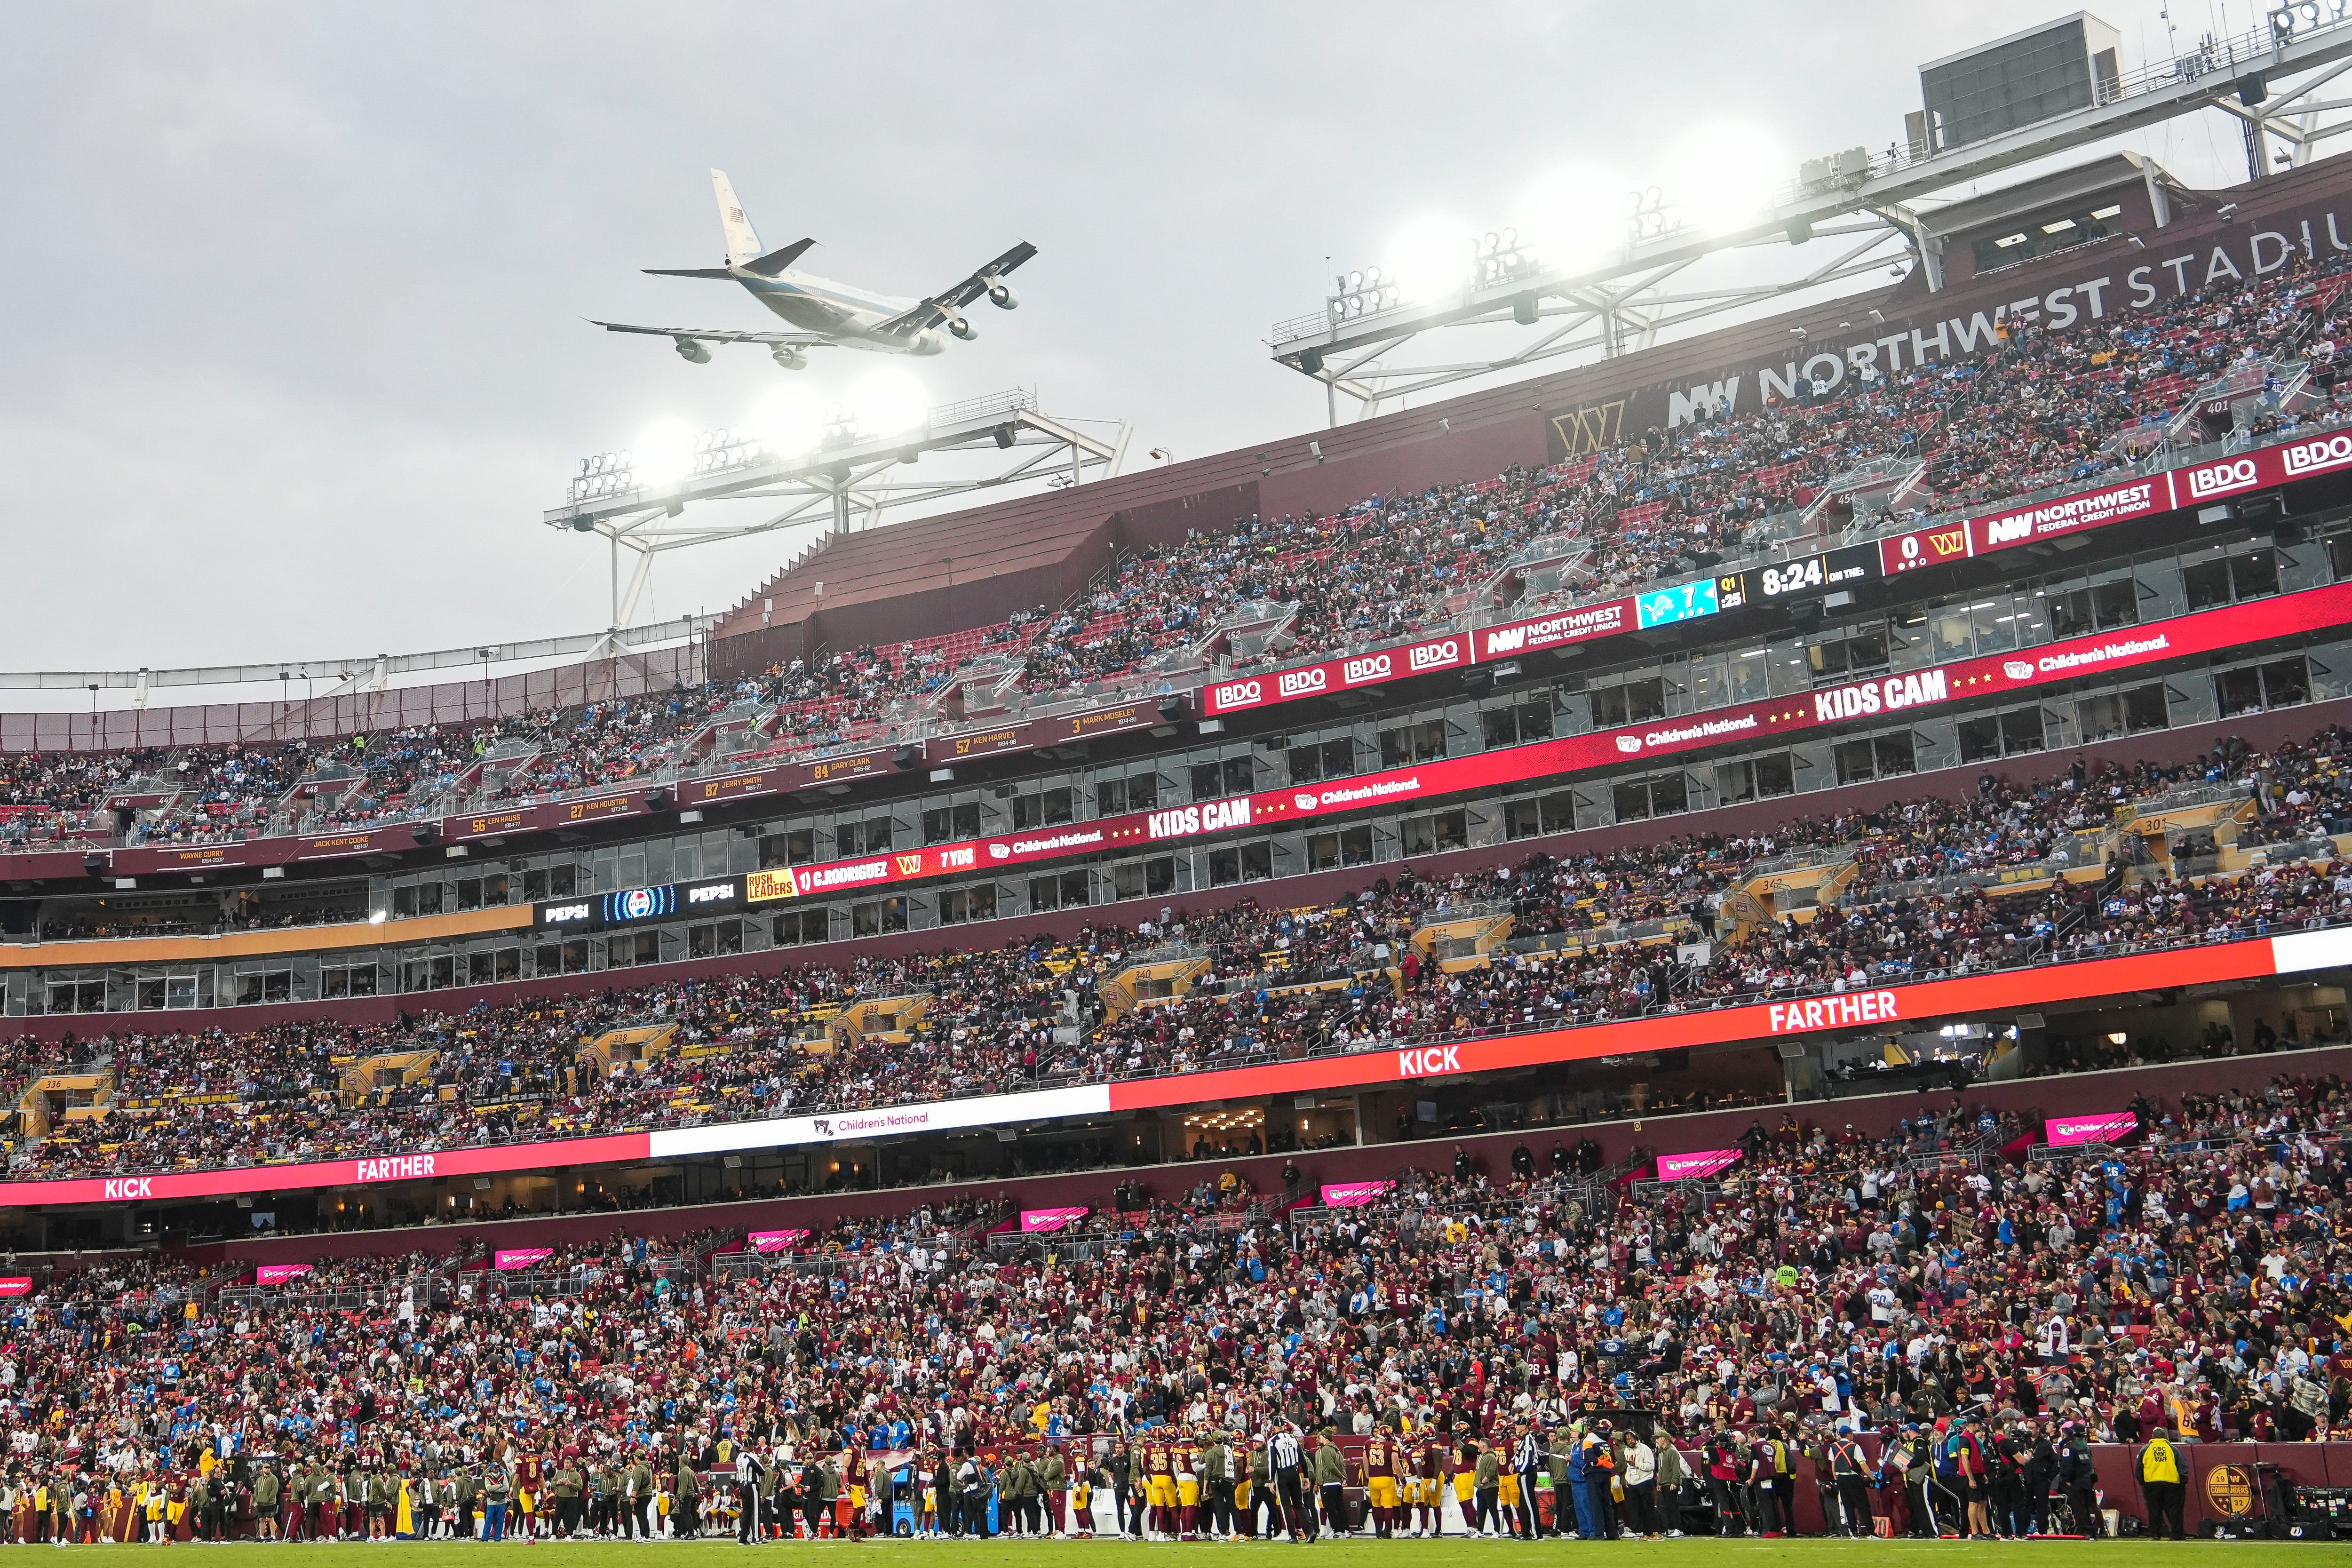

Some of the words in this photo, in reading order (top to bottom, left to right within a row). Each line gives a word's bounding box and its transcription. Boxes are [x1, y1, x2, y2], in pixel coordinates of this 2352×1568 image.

[1758, 277, 2110, 406] NORTHWEST
[2271, 383, 2282, 393] 40
[2207, 400, 2228, 414] 401
[1988, 512, 2034, 545] NW
[2035, 484, 2151, 524] NORTHWEST
[2037, 517, 2079, 533] FEDERAL
[2081, 508, 2114, 523] CREDIT
[2116, 500, 2150, 515] UNION
[1515, 567, 1531, 579] 453
[1762, 560, 1823, 596] 8:24
[1829, 571, 1843, 582] ON
[1843, 566, 1864, 579] THE:
[1721, 577, 1735, 591] Q1
[1682, 586, 1695, 608] 7
[1721, 592, 1741, 608] :25
[1225, 630, 1240, 640] 452
[1487, 626, 1526, 653] NW
[1527, 605, 1622, 637] NORTHWEST
[1528, 632, 1563, 645] FEDERAL
[1564, 625, 1592, 638] CREDIT
[1593, 620, 1621, 632] UNION
[2038, 647, 2105, 671] Children's
[961, 682, 975, 692] 451
[1815, 683, 1881, 721] KIDS
[1884, 669, 1947, 708] CAM
[1083, 714, 1103, 725] MARK
[1104, 708, 1136, 721] MOSELEY
[715, 726, 728, 734] 450
[1073, 720, 1080, 733] 3
[974, 736, 987, 745] KEN
[988, 731, 1015, 743] HARVEY
[1646, 725, 1703, 746] Children's
[956, 739, 970, 754] 57
[831, 761, 849, 770] GARY
[849, 757, 870, 767] CLARK
[815, 765, 829, 779] 84
[722, 779, 741, 788] JERRY
[742, 776, 762, 785] SMITH
[705, 783, 719, 797] 87
[1321, 786, 1373, 804] Children's
[600, 798, 628, 808] HOUSTON
[500, 814, 520, 823] HAUSS
[571, 805, 583, 818] 27
[1149, 807, 1200, 839] KIDS
[1202, 798, 1251, 830] CAM
[473, 819, 485, 833] 56
[1013, 837, 1060, 854] Children's
[180, 851, 203, 860] WAYNE
[940, 852, 948, 867] 7
[949, 848, 974, 866] YDS
[799, 871, 810, 891] 1)
[813, 861, 888, 887] C.RODRIGUEZ
[690, 884, 734, 903] PEPSI
[749, 881, 792, 898] LEADERS
[546, 904, 588, 922] PEPSI
[1770, 991, 1897, 1031] FARTHER
[378, 1059, 390, 1067] 337
[1399, 1046, 1461, 1075] KICK
[46, 1080, 61, 1089] 336
[839, 1117, 885, 1131] Children's
[358, 1155, 434, 1180] FARTHER
[2106, 1166, 2119, 1177] 16
[105, 1178, 151, 1198] KICK
[1474, 1255, 1483, 1265] 91
[615, 1275, 624, 1284] 26
[882, 1275, 890, 1285] 43
[1496, 1279, 1502, 1289] 9
[971, 1284, 979, 1292] 21
[2176, 1283, 2182, 1296] 5
[1396, 1293, 1407, 1305] 21
[2184, 1340, 2196, 1353] 17
[344, 1353, 354, 1361] 85
[438, 1356, 449, 1365] 56
[1071, 1365, 1078, 1373] 99
[1812, 1370, 1820, 1383] 9
[509, 1393, 514, 1402] 5
[384, 1405, 394, 1414] 93
[1709, 1405, 1717, 1418] 10
[321, 1453, 326, 1461] 4
[1151, 1453, 1168, 1471] 35
[1176, 1454, 1184, 1472] 6
[1369, 1449, 1385, 1466] 63
[230, 1465, 232, 1473] 1
[529, 1462, 536, 1478] 8
